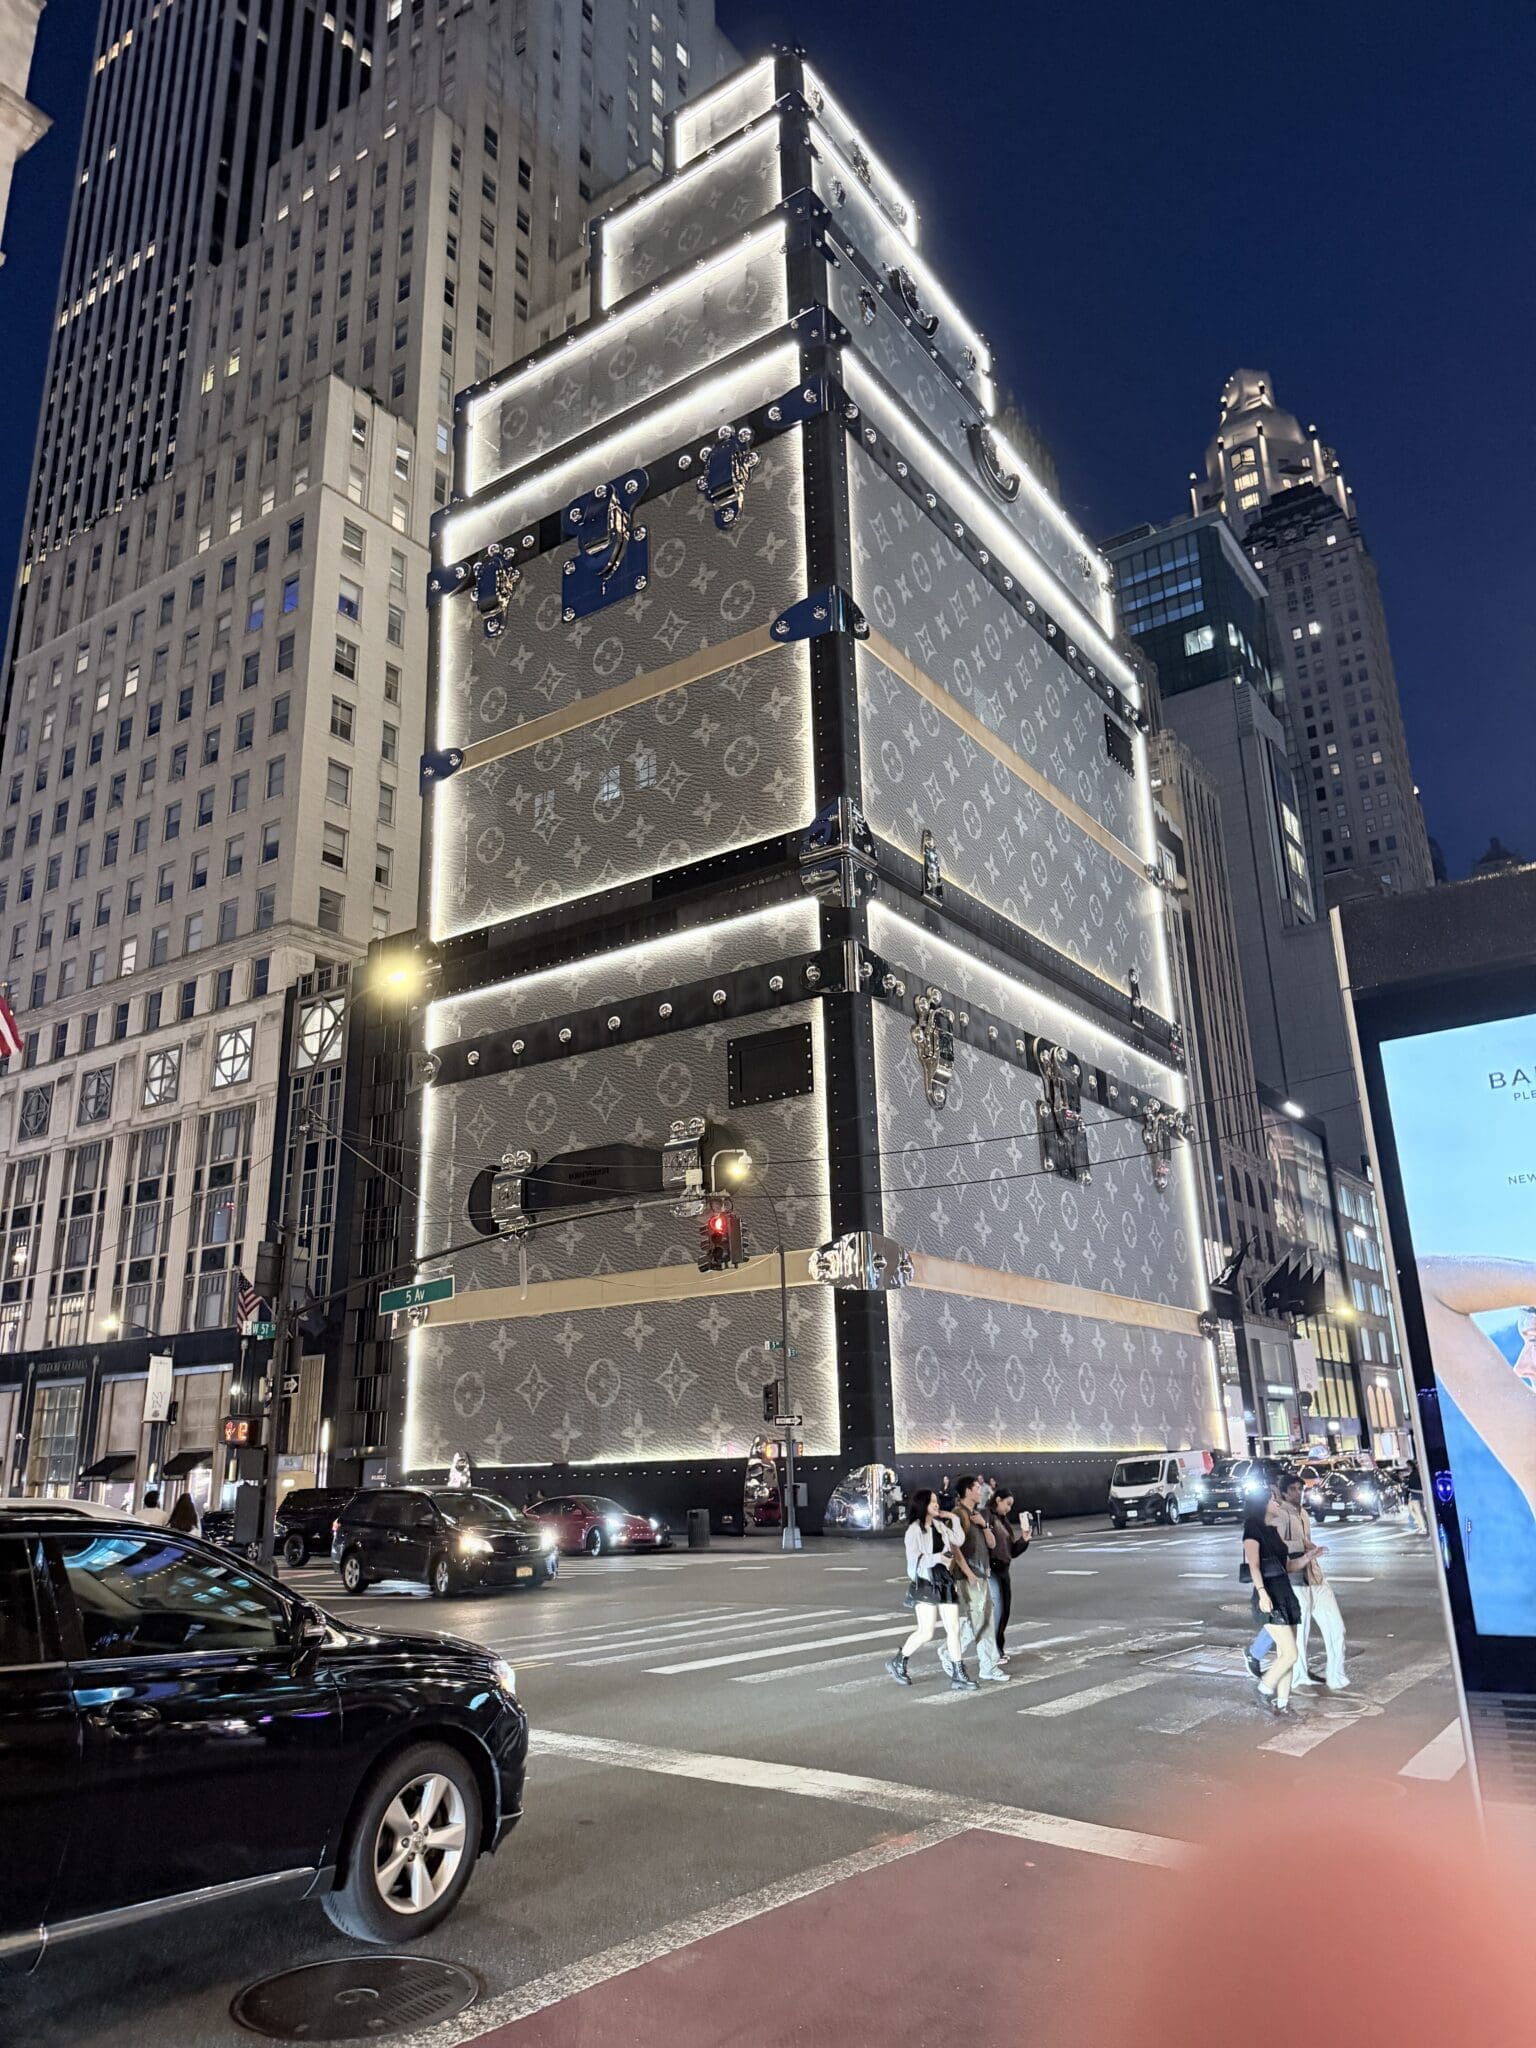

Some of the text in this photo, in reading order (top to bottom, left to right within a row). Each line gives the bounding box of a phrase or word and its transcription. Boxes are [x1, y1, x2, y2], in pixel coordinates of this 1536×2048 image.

[1489, 1066, 1536, 1089] BA
[1513, 1090, 1536, 1101] PLE
[1508, 1173, 1536, 1184] NEW
[405, 1288, 425, 1304] 5 Av
[252, 1323, 259, 1335] W
[260, 1323, 269, 1336] 57
[152, 1392, 165, 1402] NY
